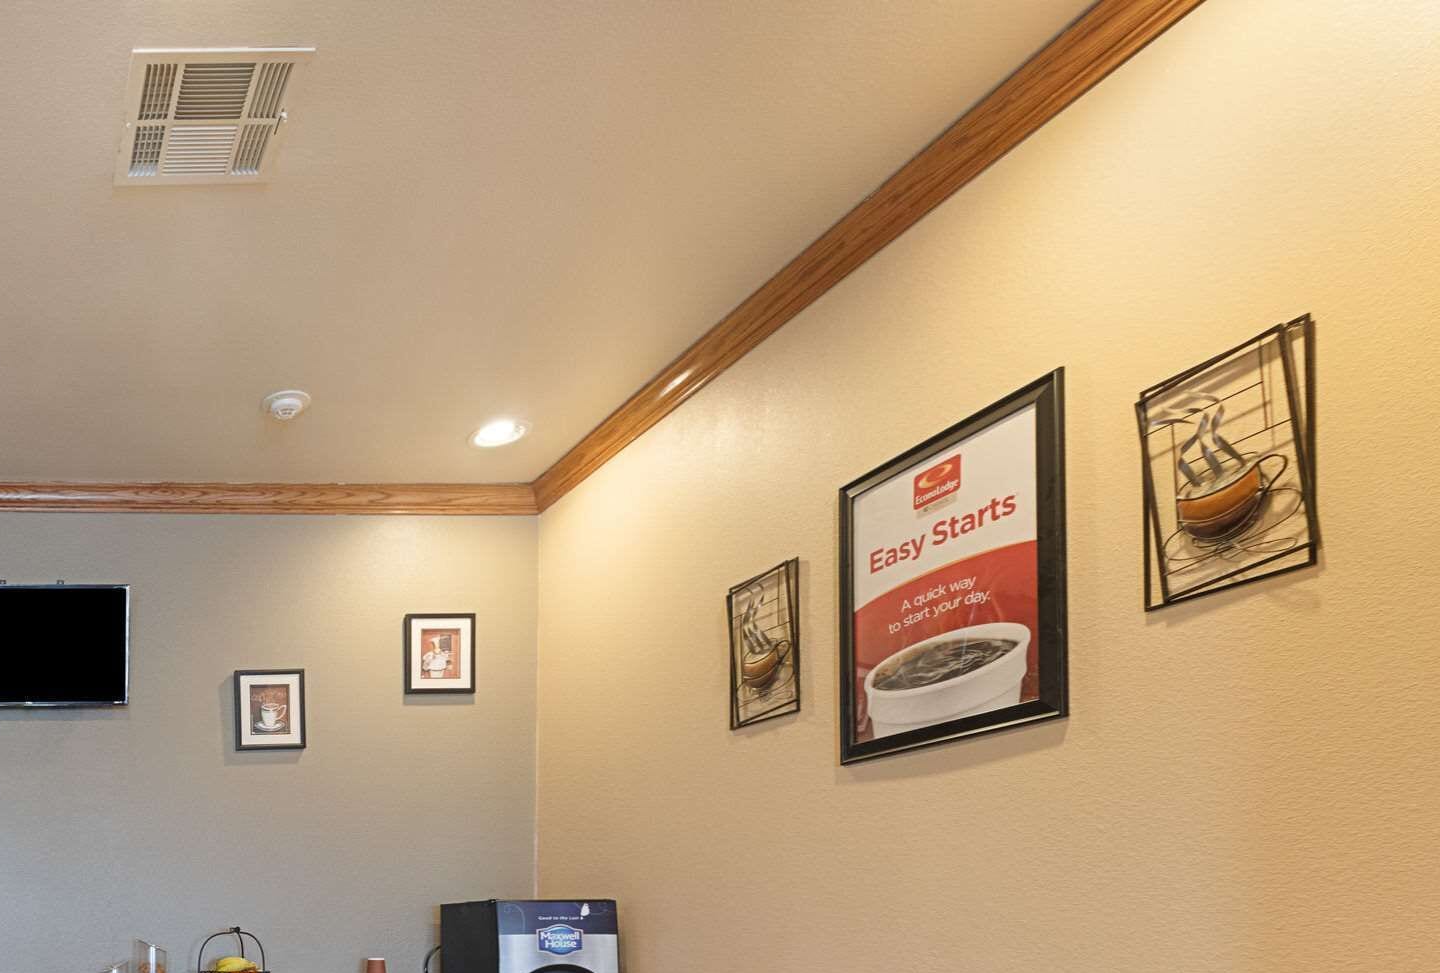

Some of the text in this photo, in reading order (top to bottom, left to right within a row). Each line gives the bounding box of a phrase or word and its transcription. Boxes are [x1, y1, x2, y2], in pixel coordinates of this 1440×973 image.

[870, 533, 926, 574] Easy
[932, 494, 1017, 546] Starts
[888, 589, 991, 635] to start your day.
[900, 575, 977, 614] A quick way
[540, 931, 580, 941] Maxwell
[545, 939, 577, 949] House
